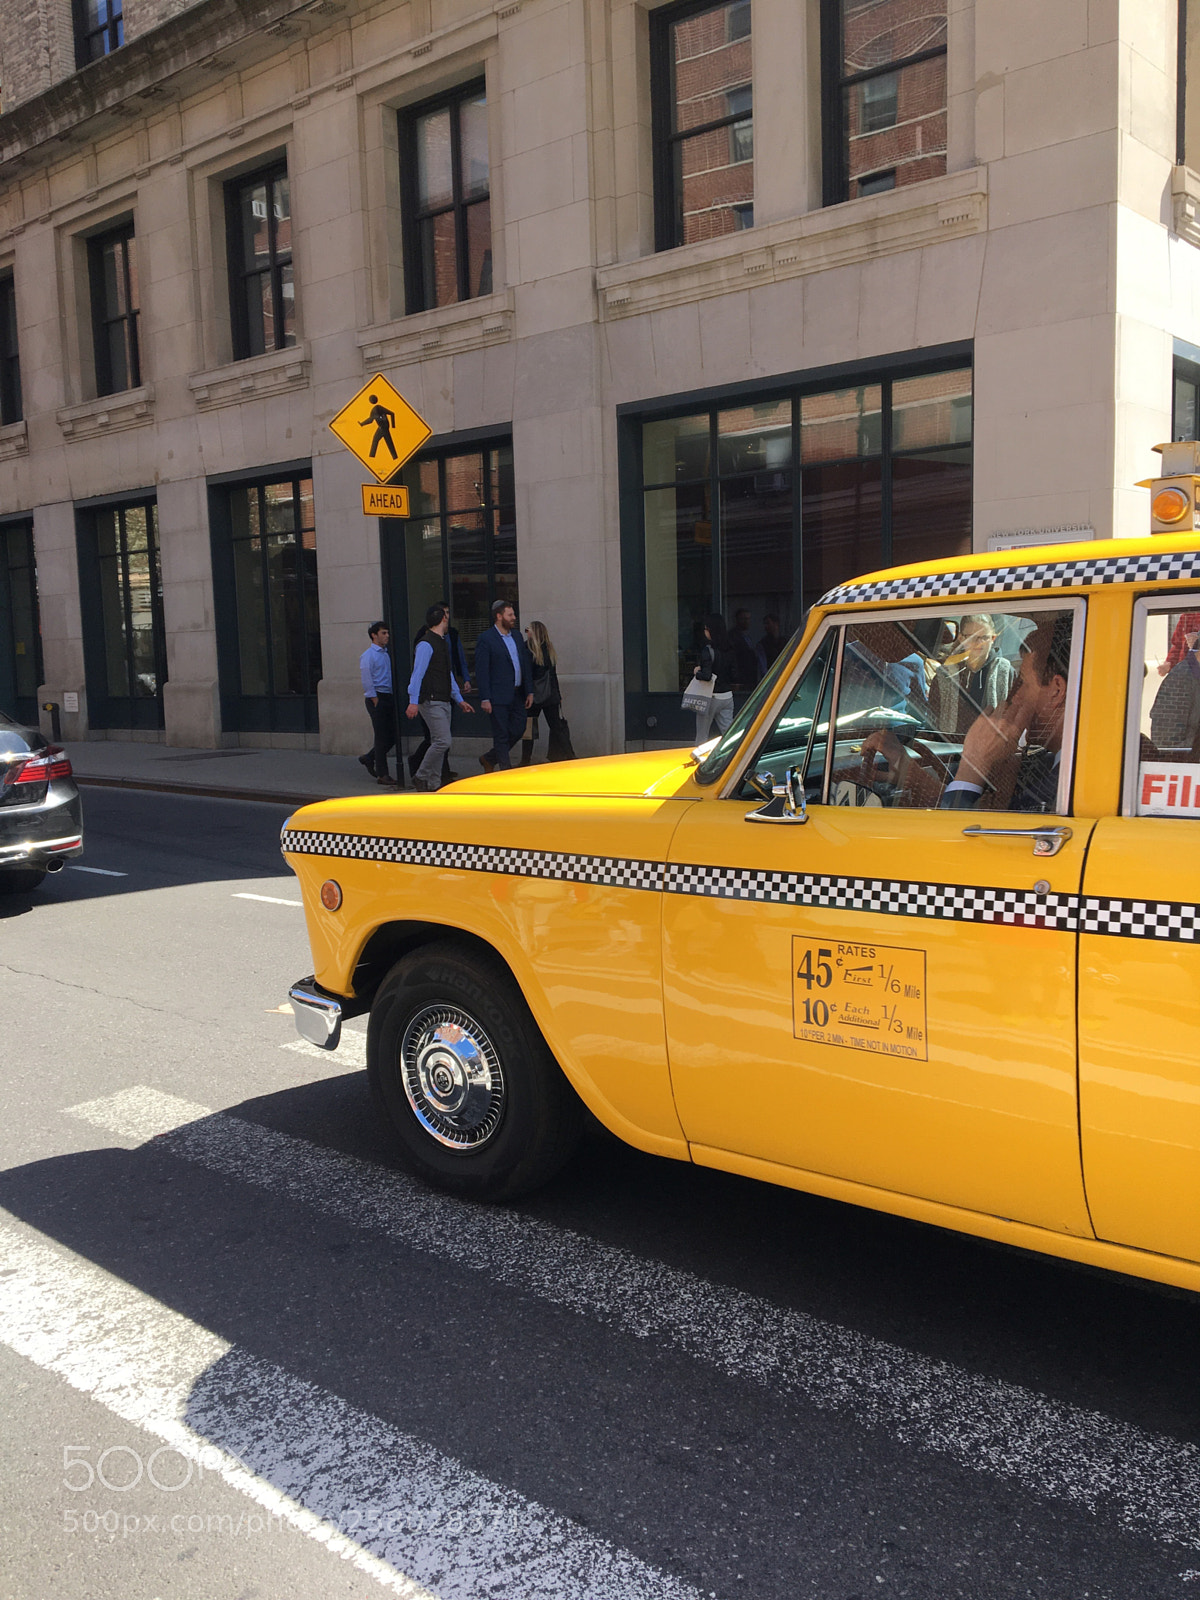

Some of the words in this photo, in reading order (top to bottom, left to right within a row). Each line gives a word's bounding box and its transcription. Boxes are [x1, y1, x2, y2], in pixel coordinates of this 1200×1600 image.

[370, 493, 403, 508] AHEAD
[1014, 527, 1037, 536] YORK
[1039, 523, 1092, 534] UNIVERSITY
[837, 944, 876, 958] RATES
[843, 966, 873, 984] First
[877, 964, 901, 993] 1/6
[904, 984, 920, 999] Mile
[844, 1002, 870, 1015] Each
[839, 1014, 880, 1026] Additional
[882, 1004, 903, 1034] 1/3
[906, 1026, 923, 1041] Mile
[850, 1036, 865, 1048] TIME
[866, 1039, 880, 1051] NOT
[882, 1043, 889, 1053] IN
[890, 1044, 918, 1057] MOTION
